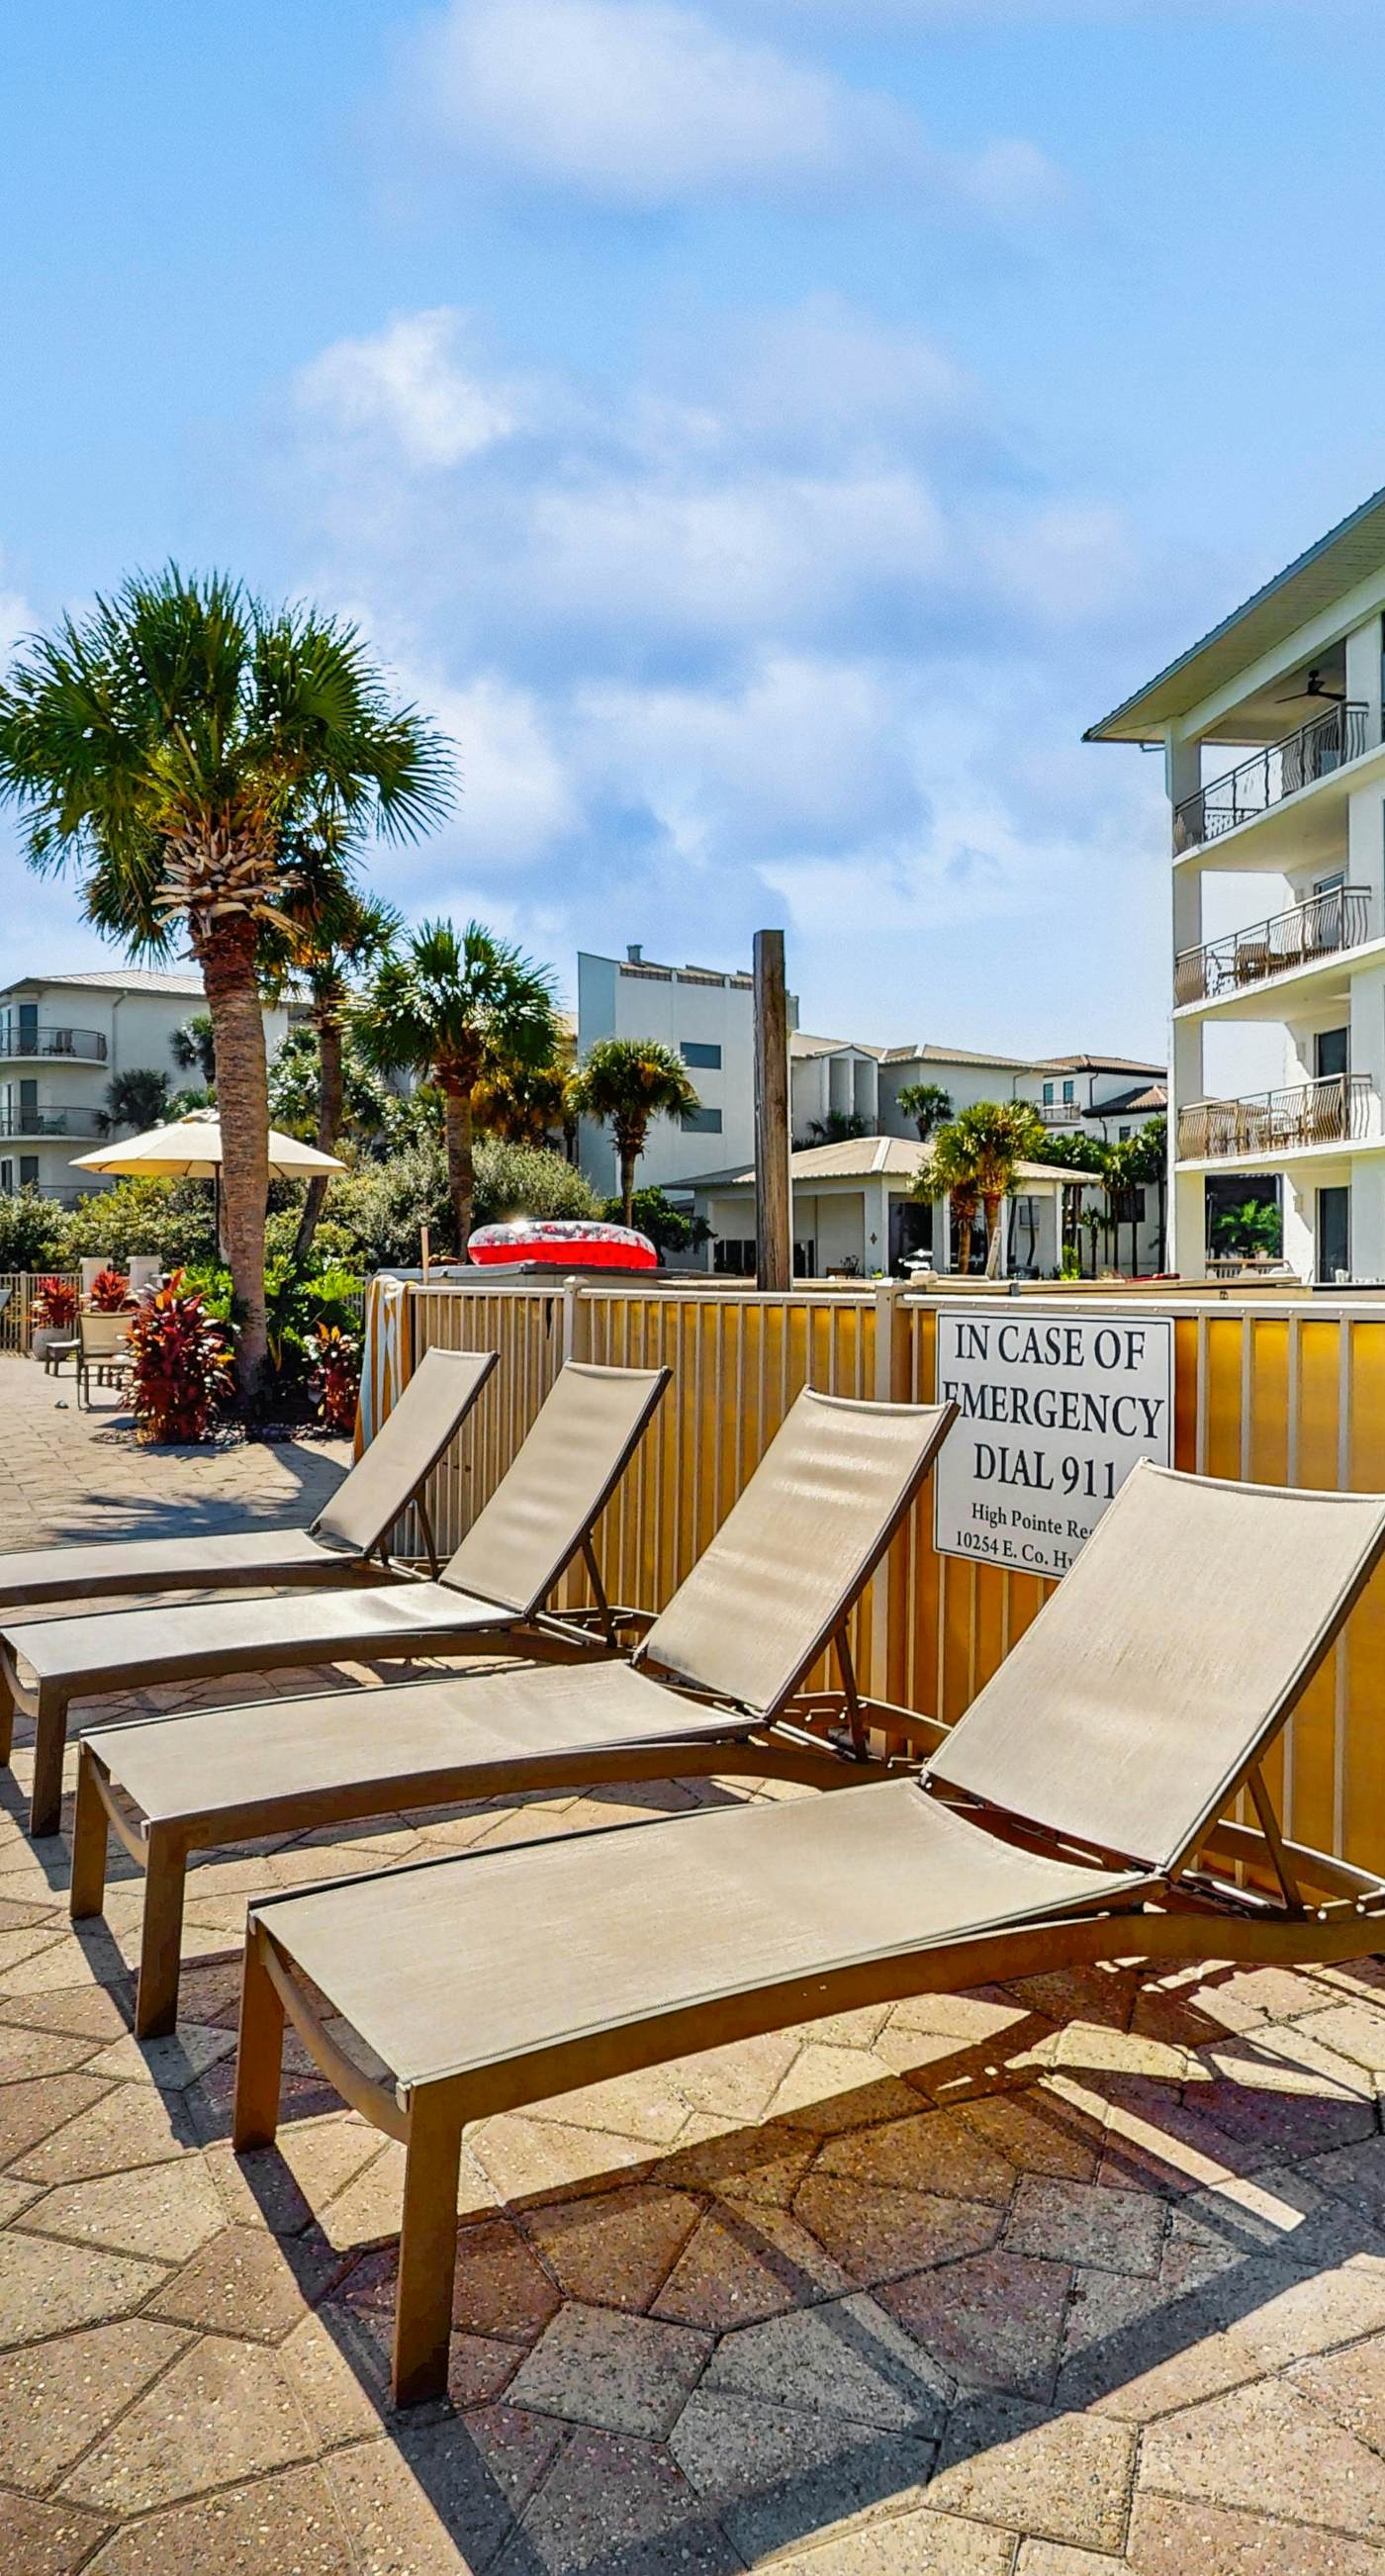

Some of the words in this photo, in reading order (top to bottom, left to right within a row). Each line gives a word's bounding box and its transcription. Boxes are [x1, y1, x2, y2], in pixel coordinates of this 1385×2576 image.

[955, 1324, 990, 1360] IN
[998, 1326, 1084, 1366] CASE
[1094, 1330, 1146, 1370] OF
[942, 1381, 1165, 1439] EMERGENCY
[973, 1443, 1054, 1490] DIAL
[1062, 1456, 1115, 1499] 911
[971, 1503, 1007, 1527] High
[1011, 1511, 1062, 1534] Pointe
[956, 1530, 999, 1556] 10254
[1003, 1540, 1017, 1558] E.
[1021, 1544, 1049, 1565] Co.
[1053, 1549, 1075, 1569] H
